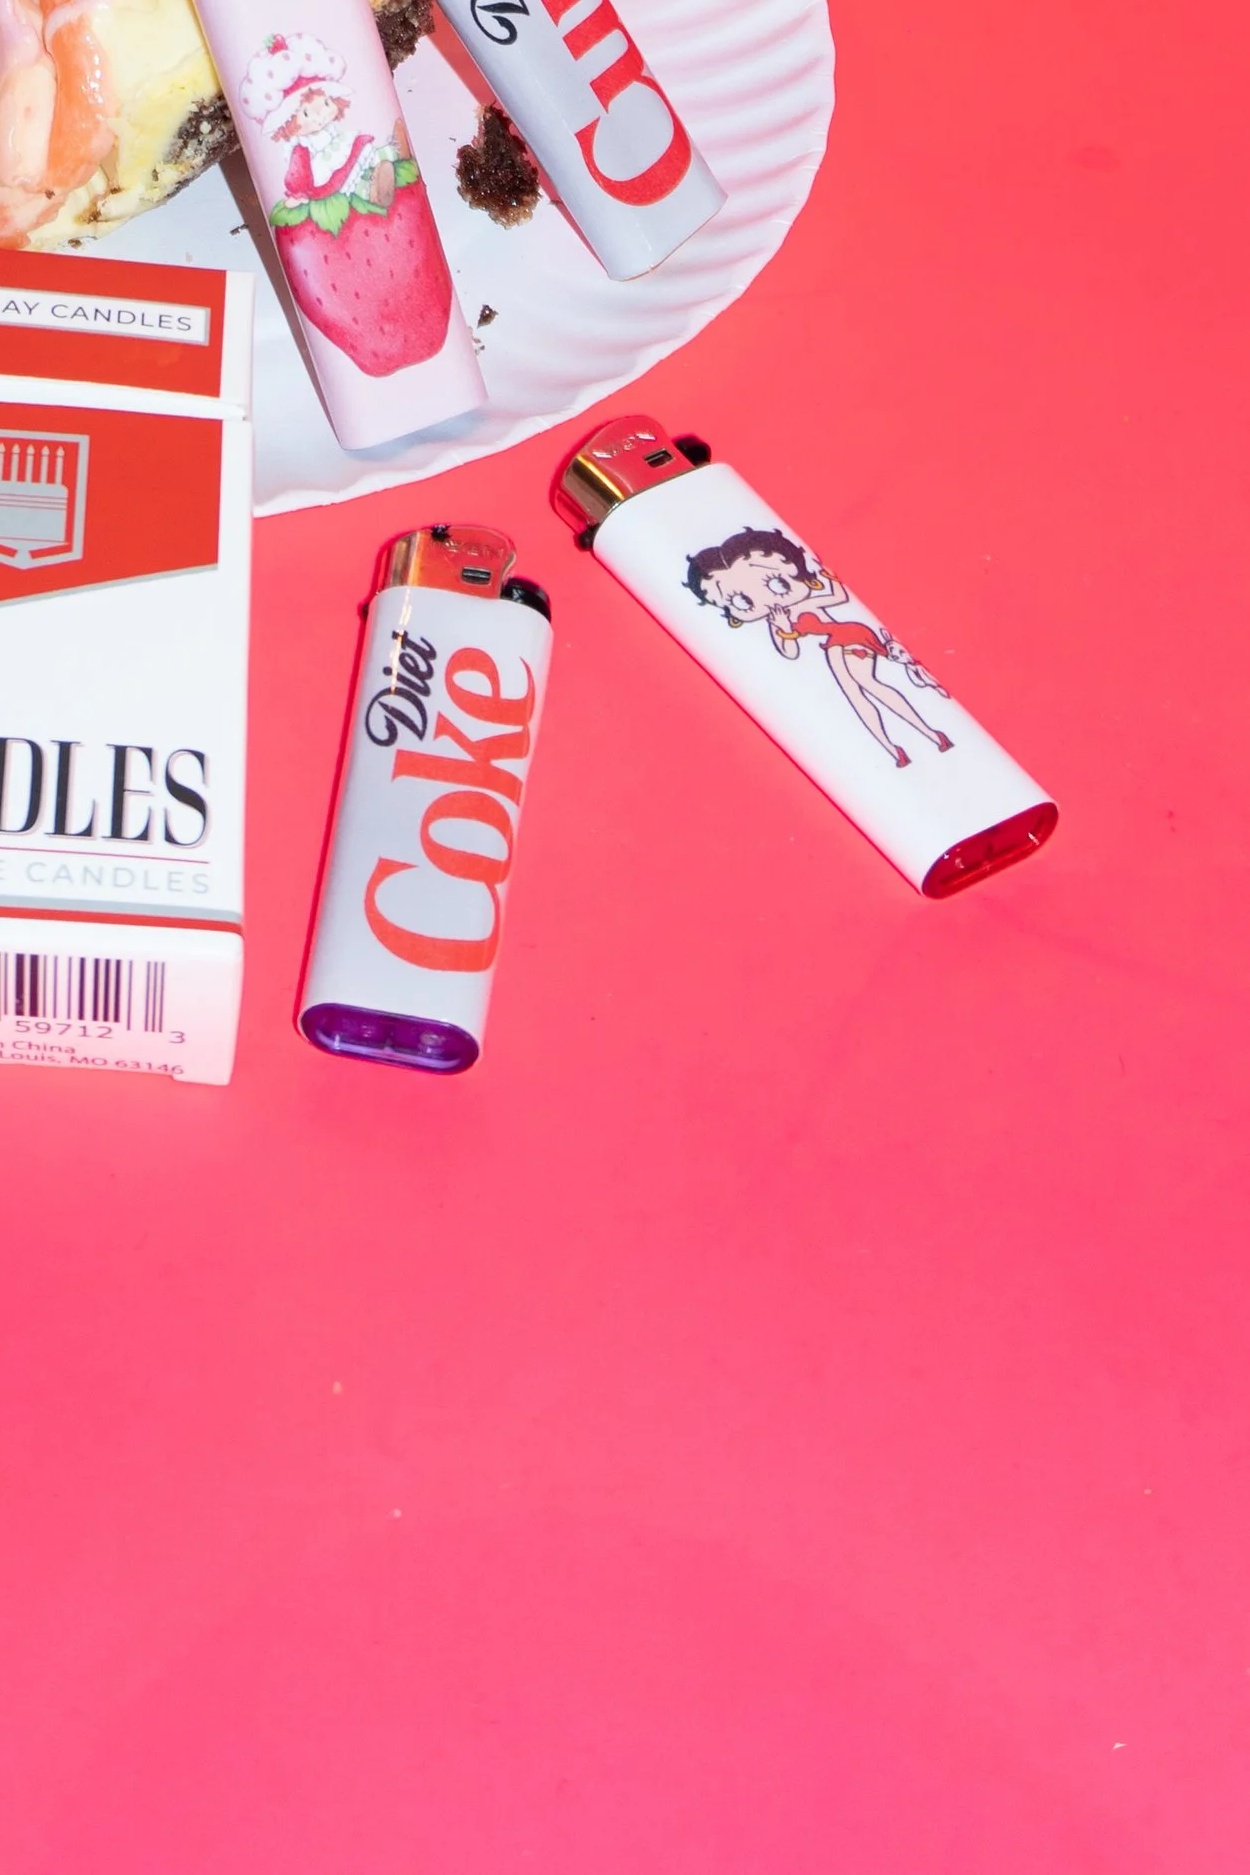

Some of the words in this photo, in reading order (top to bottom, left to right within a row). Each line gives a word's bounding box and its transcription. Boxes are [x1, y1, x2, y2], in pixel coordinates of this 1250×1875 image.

[50, 303, 193, 332] CANDLES
[364, 629, 438, 748] Diet
[363, 645, 537, 973] Coke
[25, 861, 211, 895] CANDLES
[14, 1019, 114, 1040] 59712
[169, 1030, 186, 1044] 3
[12, 1040, 77, 1055] China
[70, 1055, 109, 1067] MO
[115, 1059, 185, 1076] 63146
